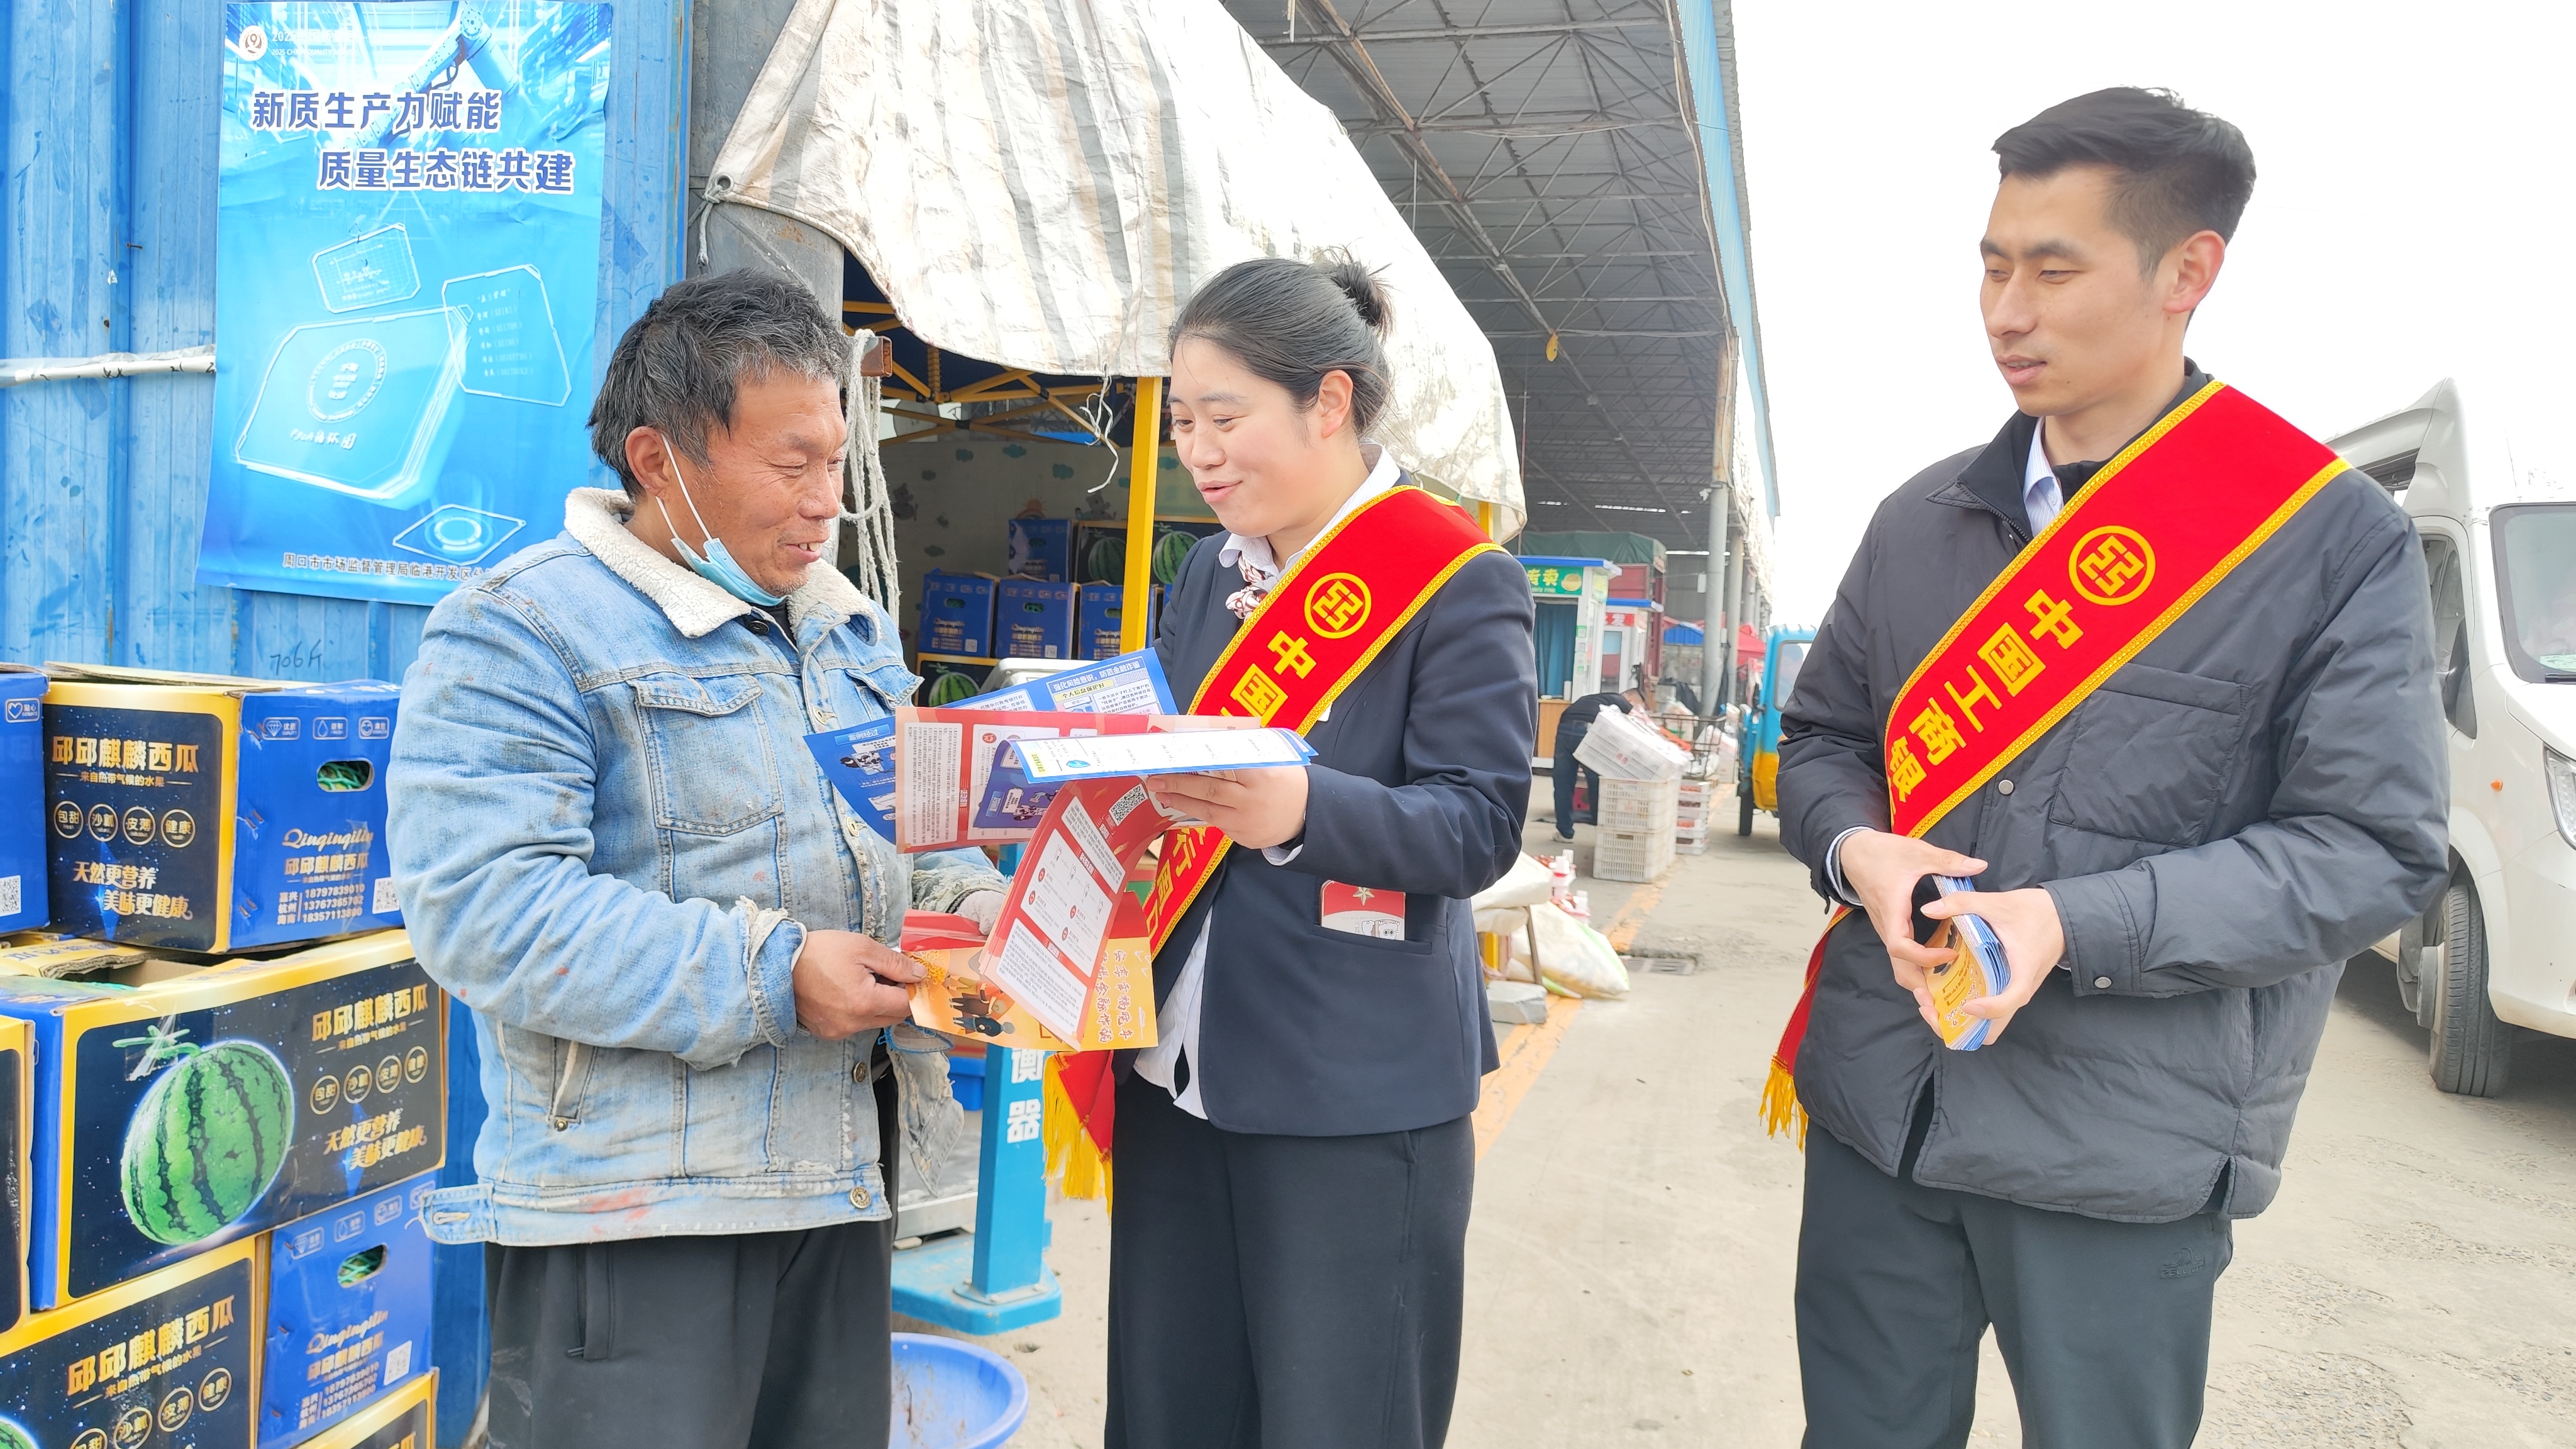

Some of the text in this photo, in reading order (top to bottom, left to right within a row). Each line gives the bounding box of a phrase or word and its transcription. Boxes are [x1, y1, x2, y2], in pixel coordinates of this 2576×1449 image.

[252, 91, 502, 130] 新质生产力赋能
[319, 150, 574, 191] 质量生态链共建
[1230, 629, 1317, 728] 中国
[1889, 588, 2084, 802] 中国工商银
[52, 735, 199, 774] 邱邱麒麟西瓜
[80, 770, 165, 788] 来自热带气候的水果
[57, 809, 80, 824] 包甜
[126, 817, 152, 832] 皮薄
[165, 819, 192, 835] 健康
[72, 860, 157, 890] 天然更营养
[284, 852, 370, 876] 邱邱麒麟西瓜
[103, 889, 193, 921] 美味更健康
[311, 983, 428, 1043] 邱邱麒麟西瓜
[323, 1108, 404, 1156] 天然更营养
[349, 1124, 428, 1172] 美味更健康
[67, 1294, 235, 1397] 邱邱麒麟西瓜
